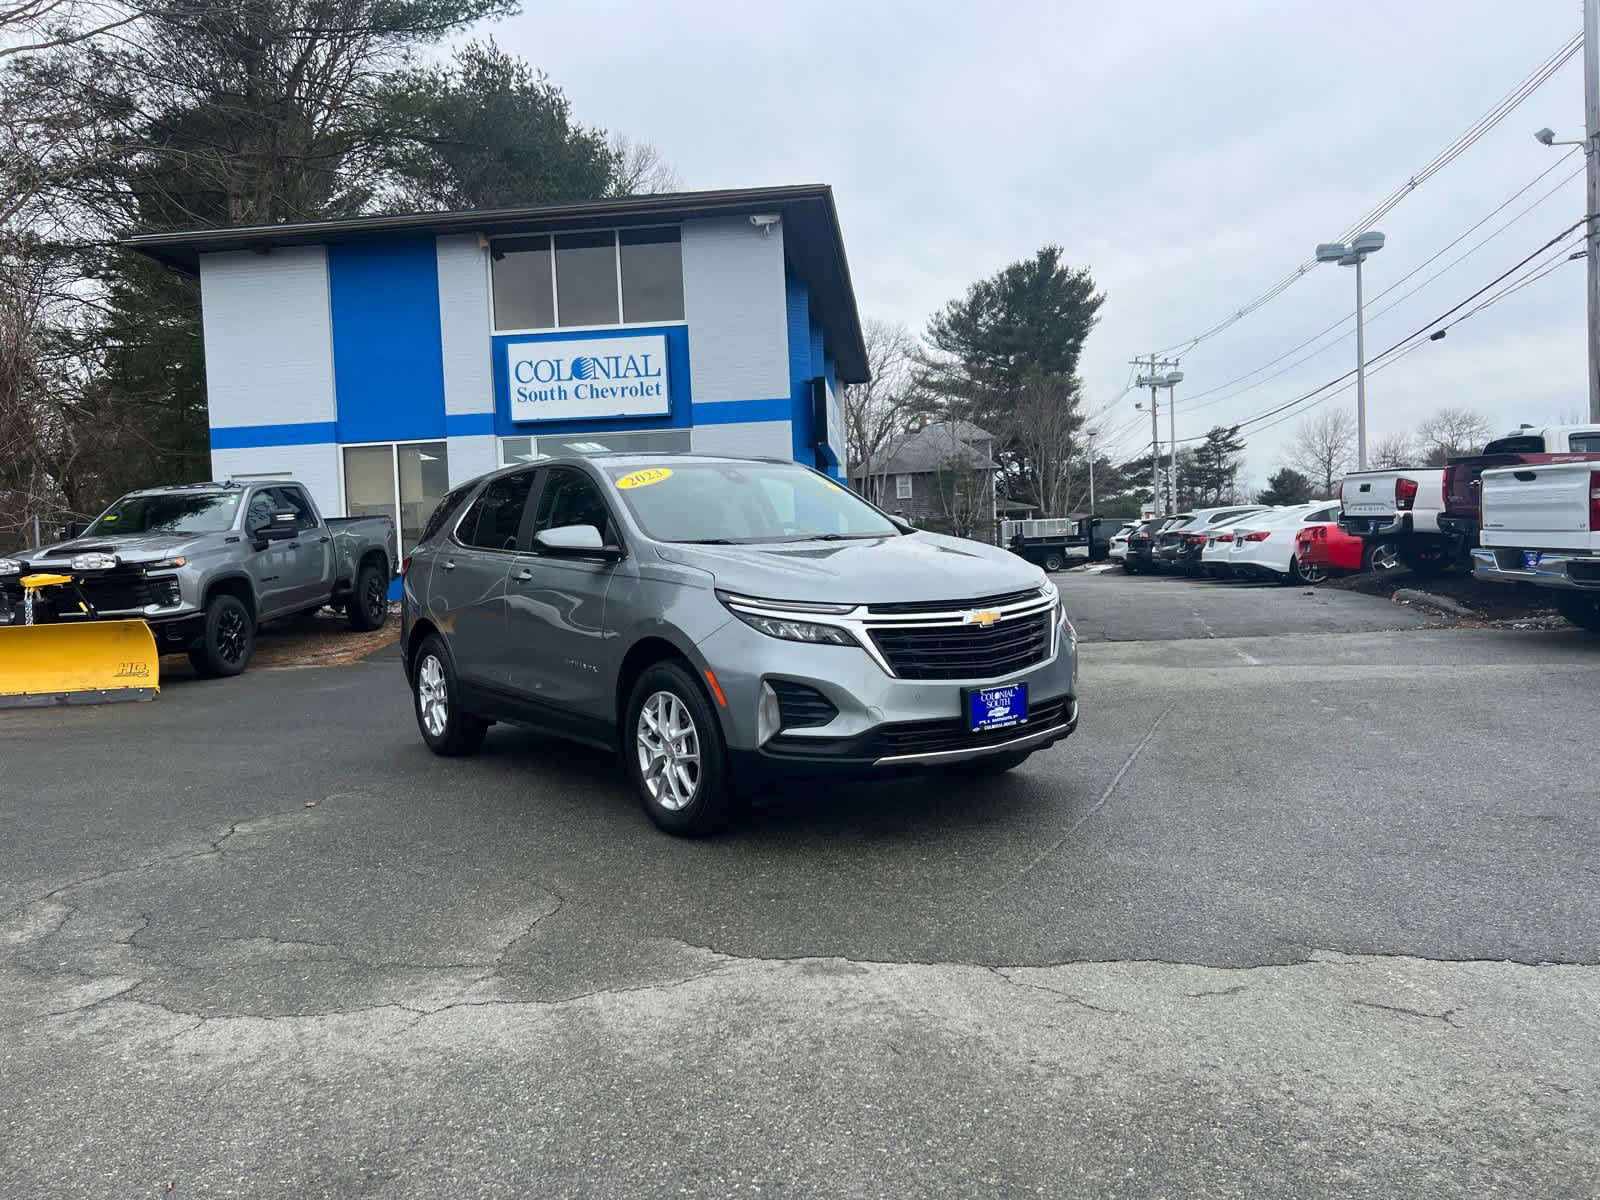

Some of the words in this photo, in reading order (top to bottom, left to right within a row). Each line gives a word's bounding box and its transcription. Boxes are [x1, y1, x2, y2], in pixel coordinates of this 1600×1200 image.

[514, 354, 662, 384] COLONIAL
[517, 385, 568, 403] South
[574, 380, 662, 400] Chevrolet
[625, 470, 663, 486] 2023
[980, 689, 1016, 702] COLONIAL
[986, 698, 1011, 709] SOUTH
